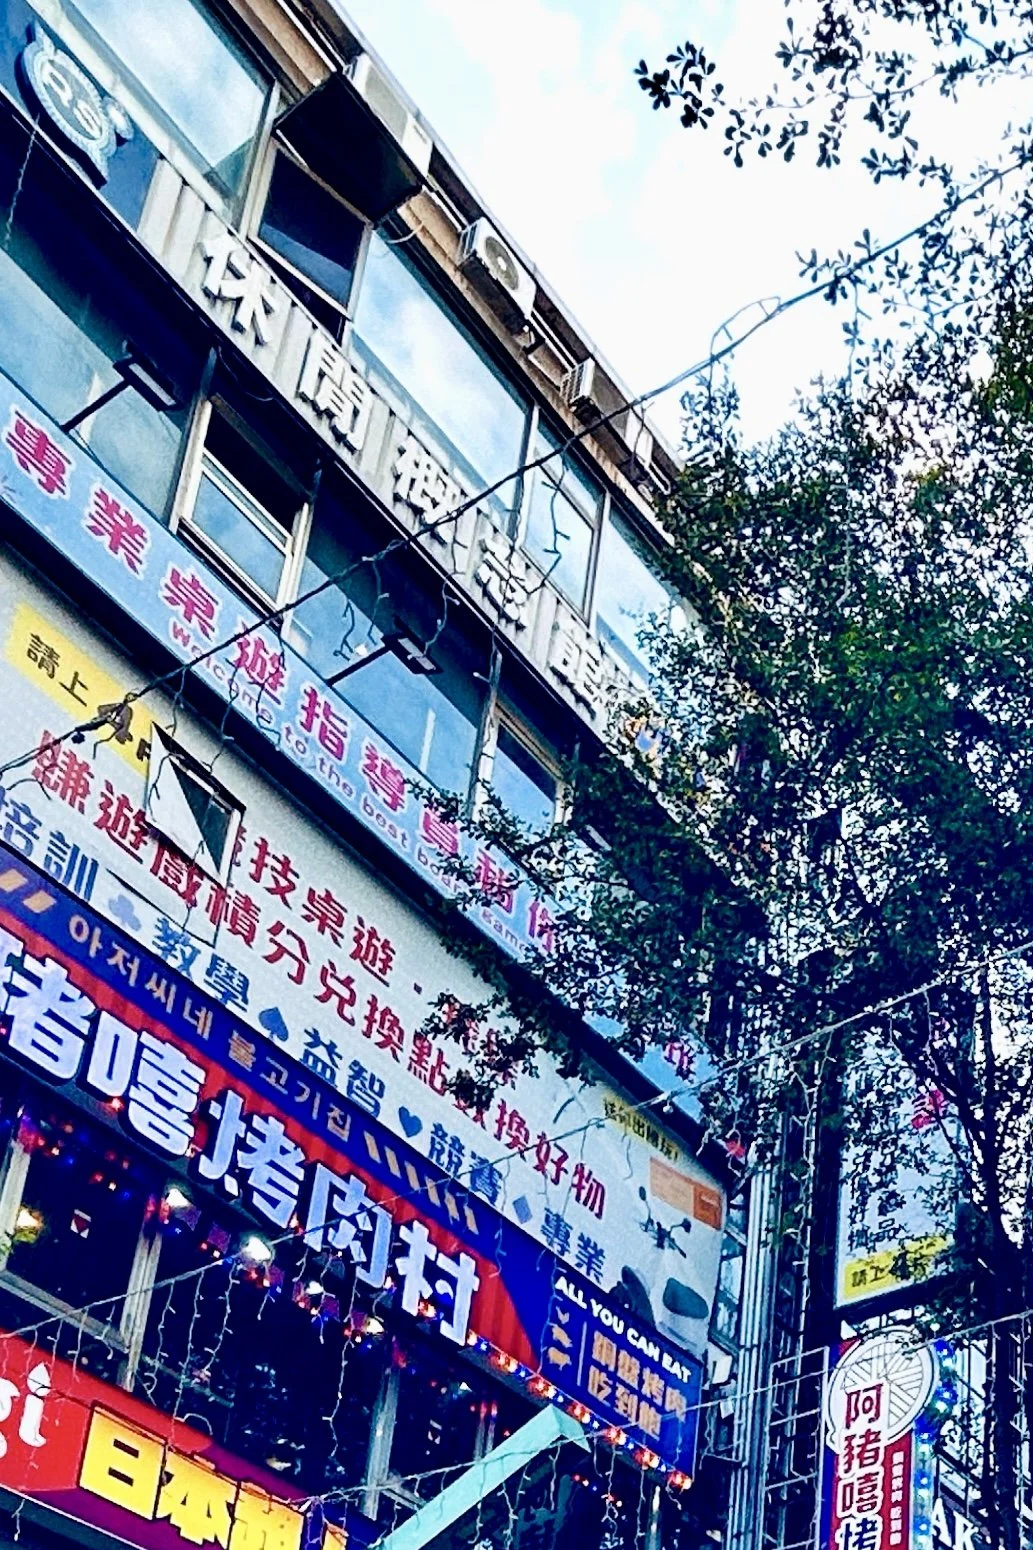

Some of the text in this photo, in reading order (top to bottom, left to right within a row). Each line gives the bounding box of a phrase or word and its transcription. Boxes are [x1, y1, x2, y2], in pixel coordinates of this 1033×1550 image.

[283, 725, 309, 756] to
[316, 752, 355, 799] the
[362, 799, 408, 847] best
[69, 914, 214, 1041] 아저씨네
[229, 1029, 352, 1143] 불고기집
[152, 917, 250, 1012] 教學
[300, 1026, 386, 1120] 益智
[540, 1207, 606, 1284] 專業
[555, 1276, 692, 1384] ALL YOU CAN EAT
